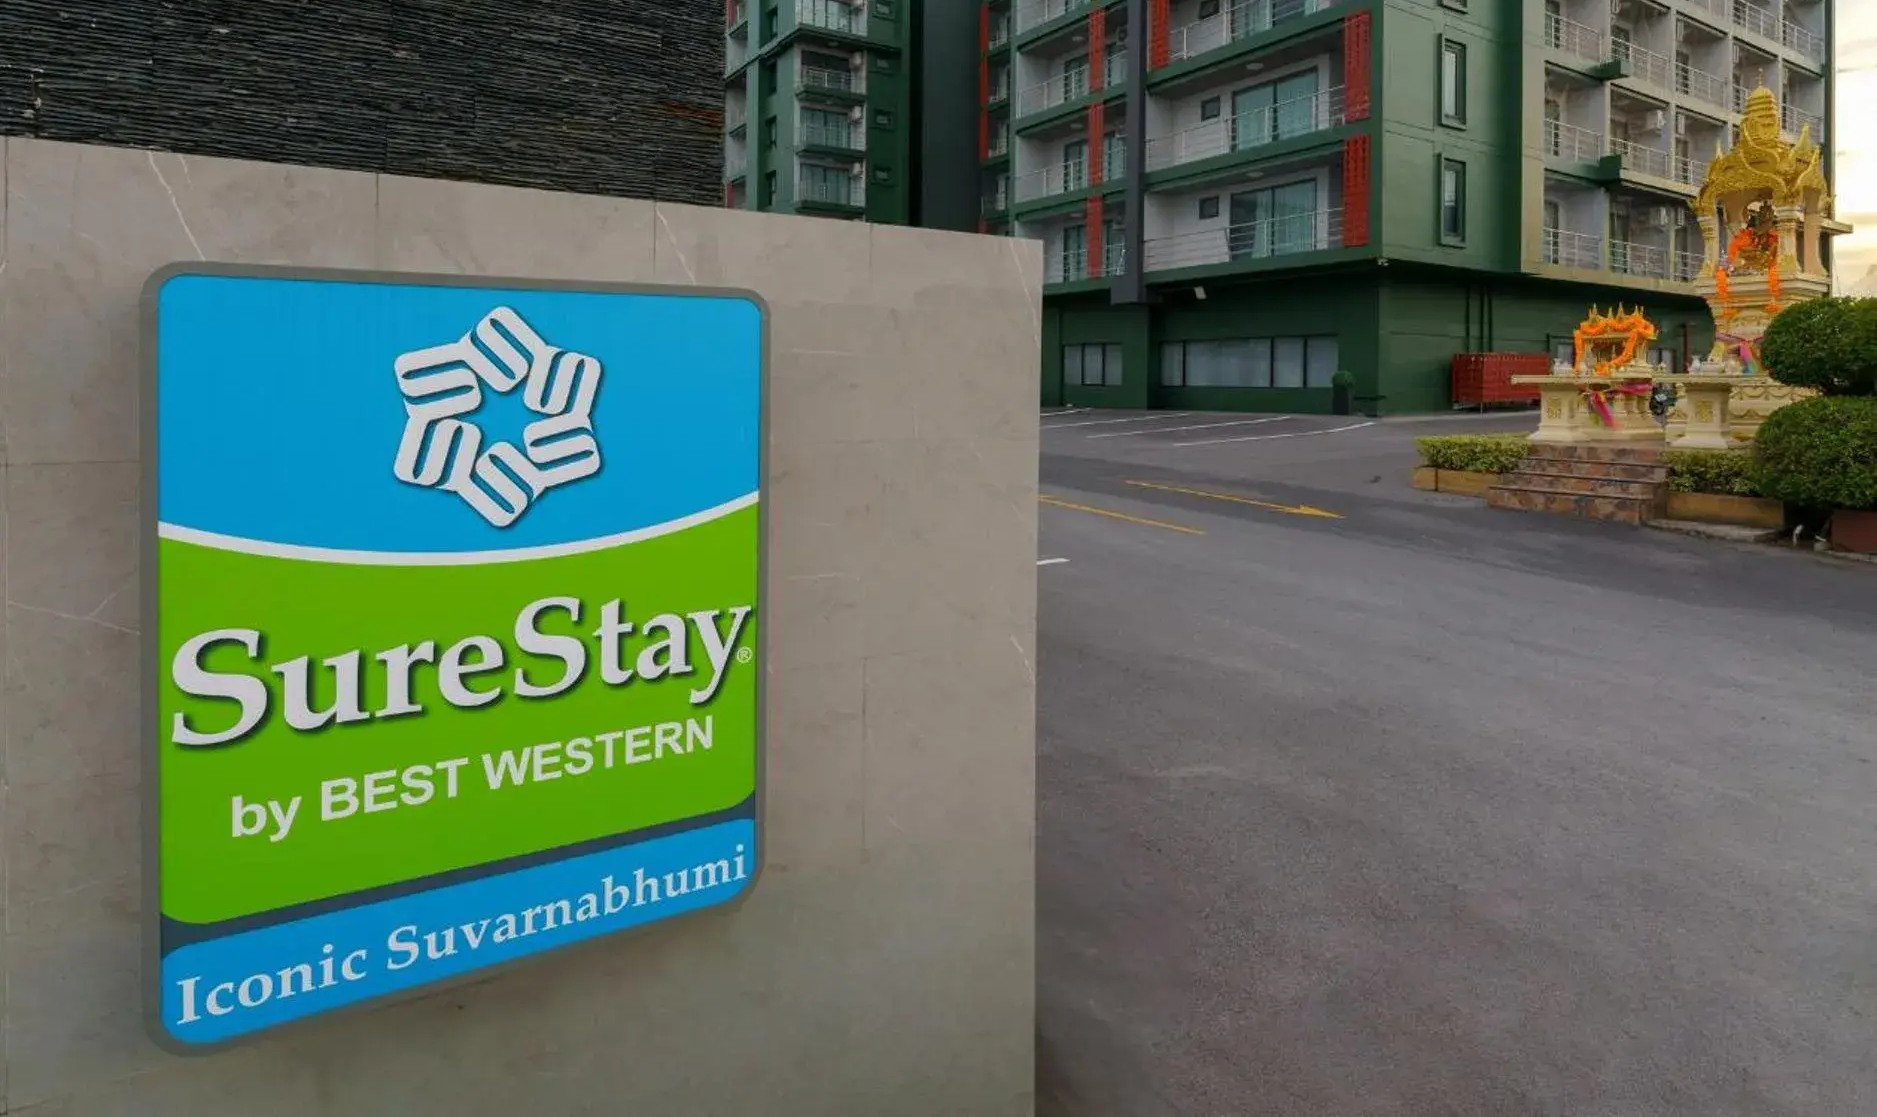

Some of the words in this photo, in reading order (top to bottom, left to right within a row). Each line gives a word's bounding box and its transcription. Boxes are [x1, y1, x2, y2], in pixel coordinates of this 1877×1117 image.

[230, 795, 302, 842] by
[320, 757, 468, 820] BEST
[482, 716, 714, 790] WESTERN
[176, 942, 367, 1026] Iconic
[386, 845, 747, 971] Suvarnabhumi
